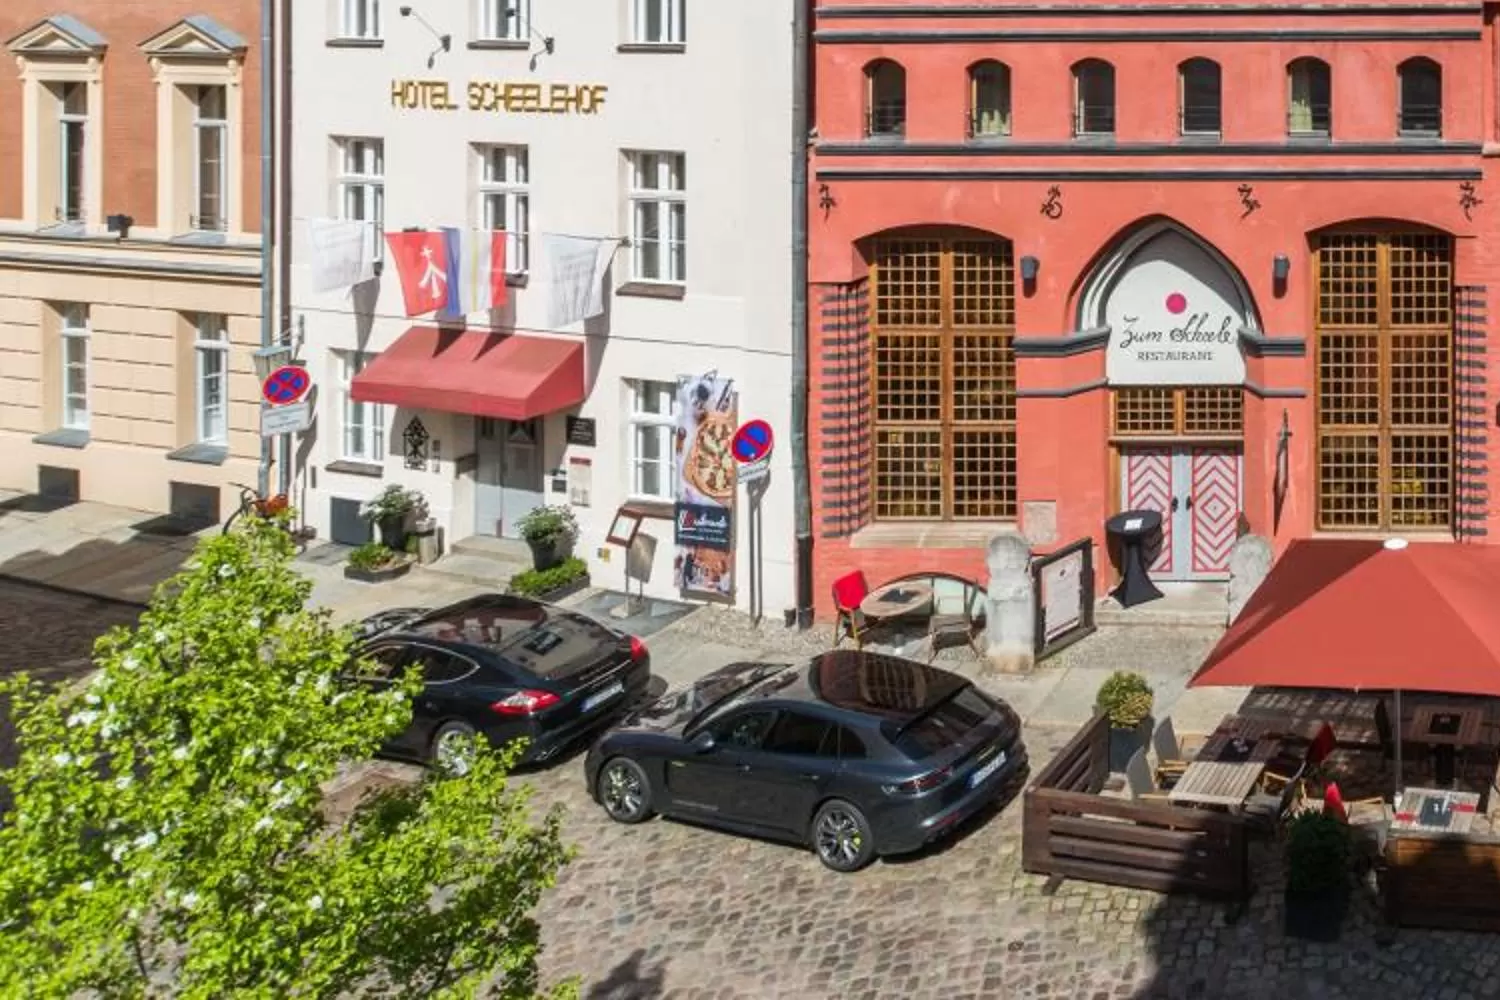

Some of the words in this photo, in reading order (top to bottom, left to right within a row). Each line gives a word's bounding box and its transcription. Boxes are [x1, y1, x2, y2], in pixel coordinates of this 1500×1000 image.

[391, 79, 459, 110] HOTEL
[466, 81, 608, 114] SCHEELEHOF
[1119, 313, 1163, 349] Zum
[1137, 351, 1215, 361] RESTAURANT
